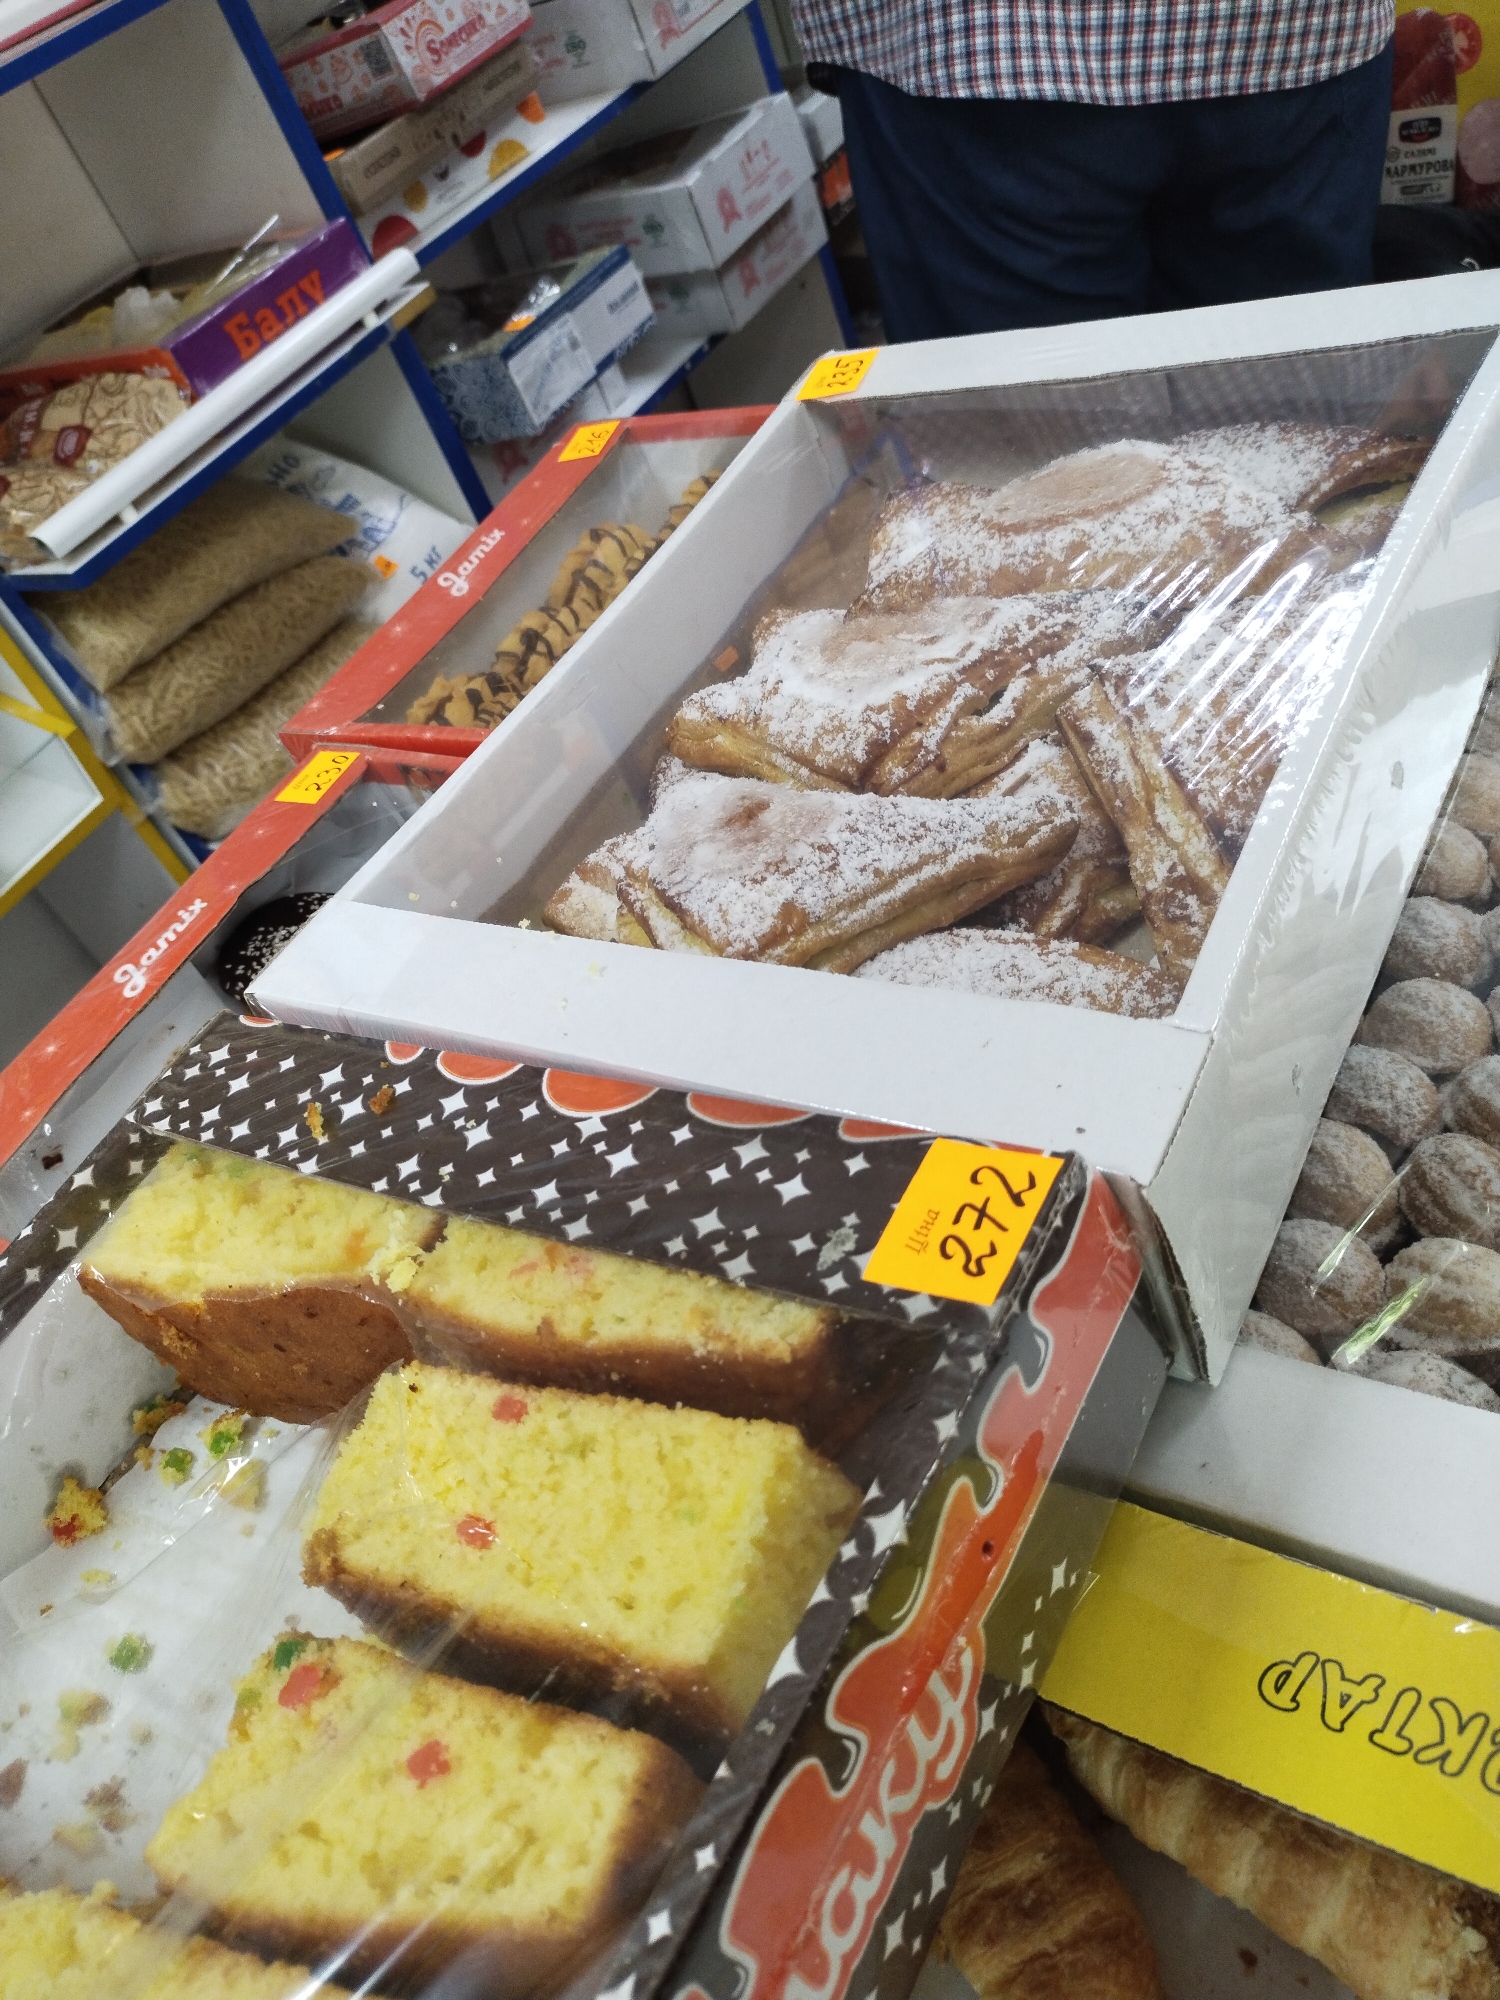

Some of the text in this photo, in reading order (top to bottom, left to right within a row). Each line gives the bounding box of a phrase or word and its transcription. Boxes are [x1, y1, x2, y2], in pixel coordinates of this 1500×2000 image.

[826, 358, 864, 388] 235
[578, 430, 610, 453] 216
[409, 564, 428, 585] 5
[436, 527, 506, 597] Jamix
[304, 755, 350, 792] 230
[113, 898, 208, 998] Jamix
[904, 1208, 940, 1255] Ціна
[939, 1165, 1037, 1278] 272
